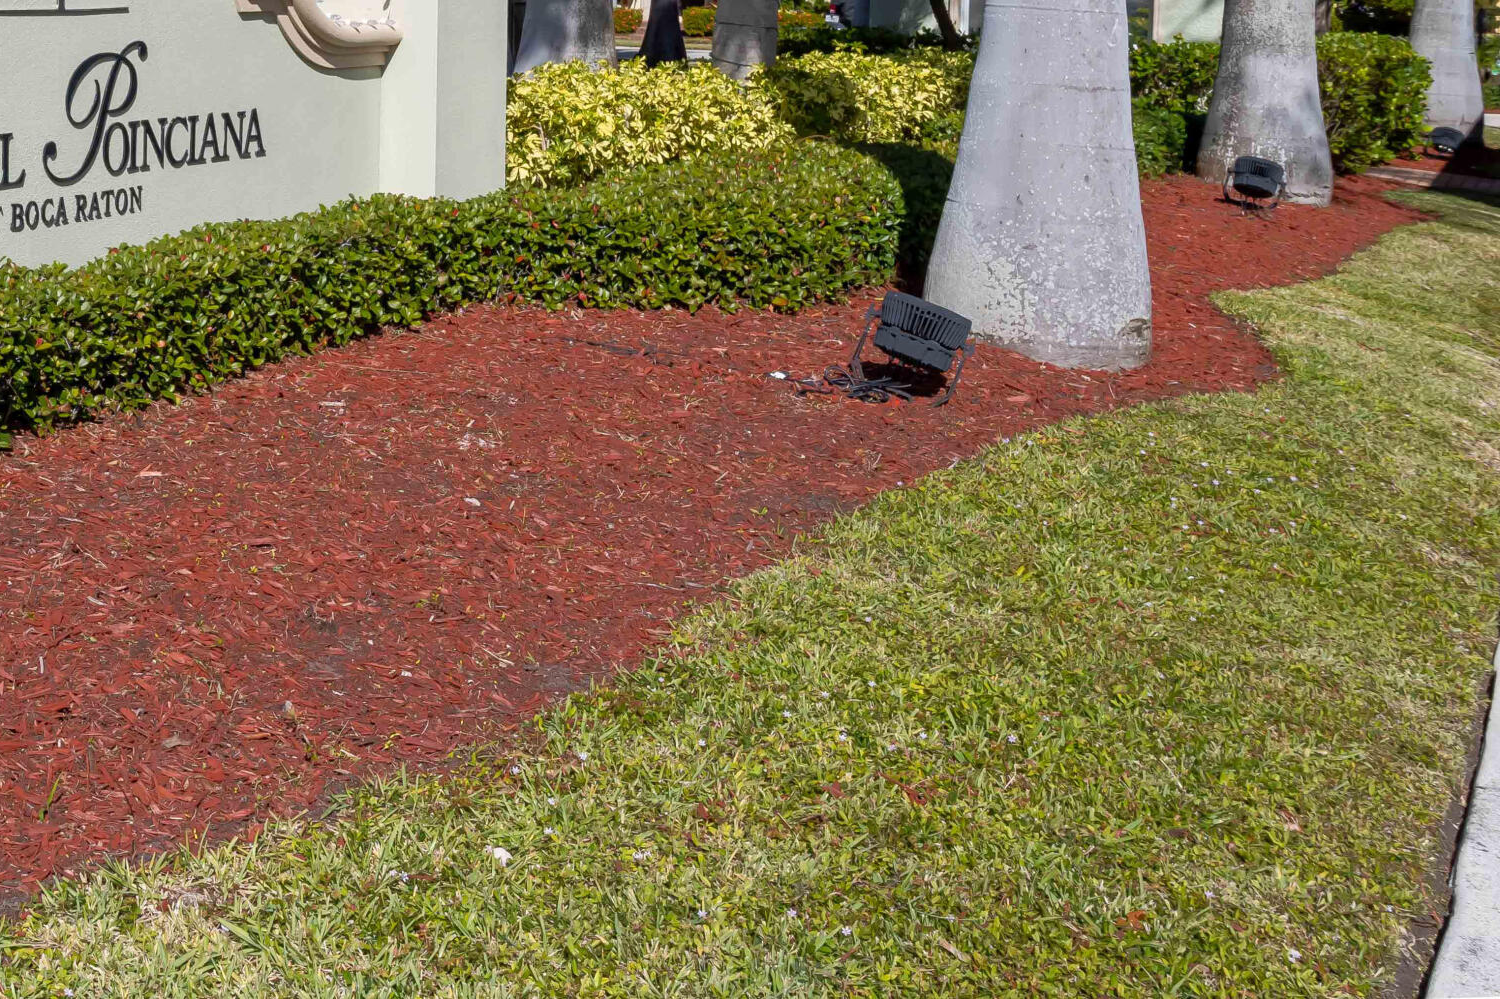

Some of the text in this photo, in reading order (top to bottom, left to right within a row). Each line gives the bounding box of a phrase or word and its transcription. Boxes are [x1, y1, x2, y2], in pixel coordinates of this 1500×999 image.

[43, 40, 266, 187] POINCIANA
[10, 197, 69, 233] BOCA
[74, 185, 143, 223] RATON
